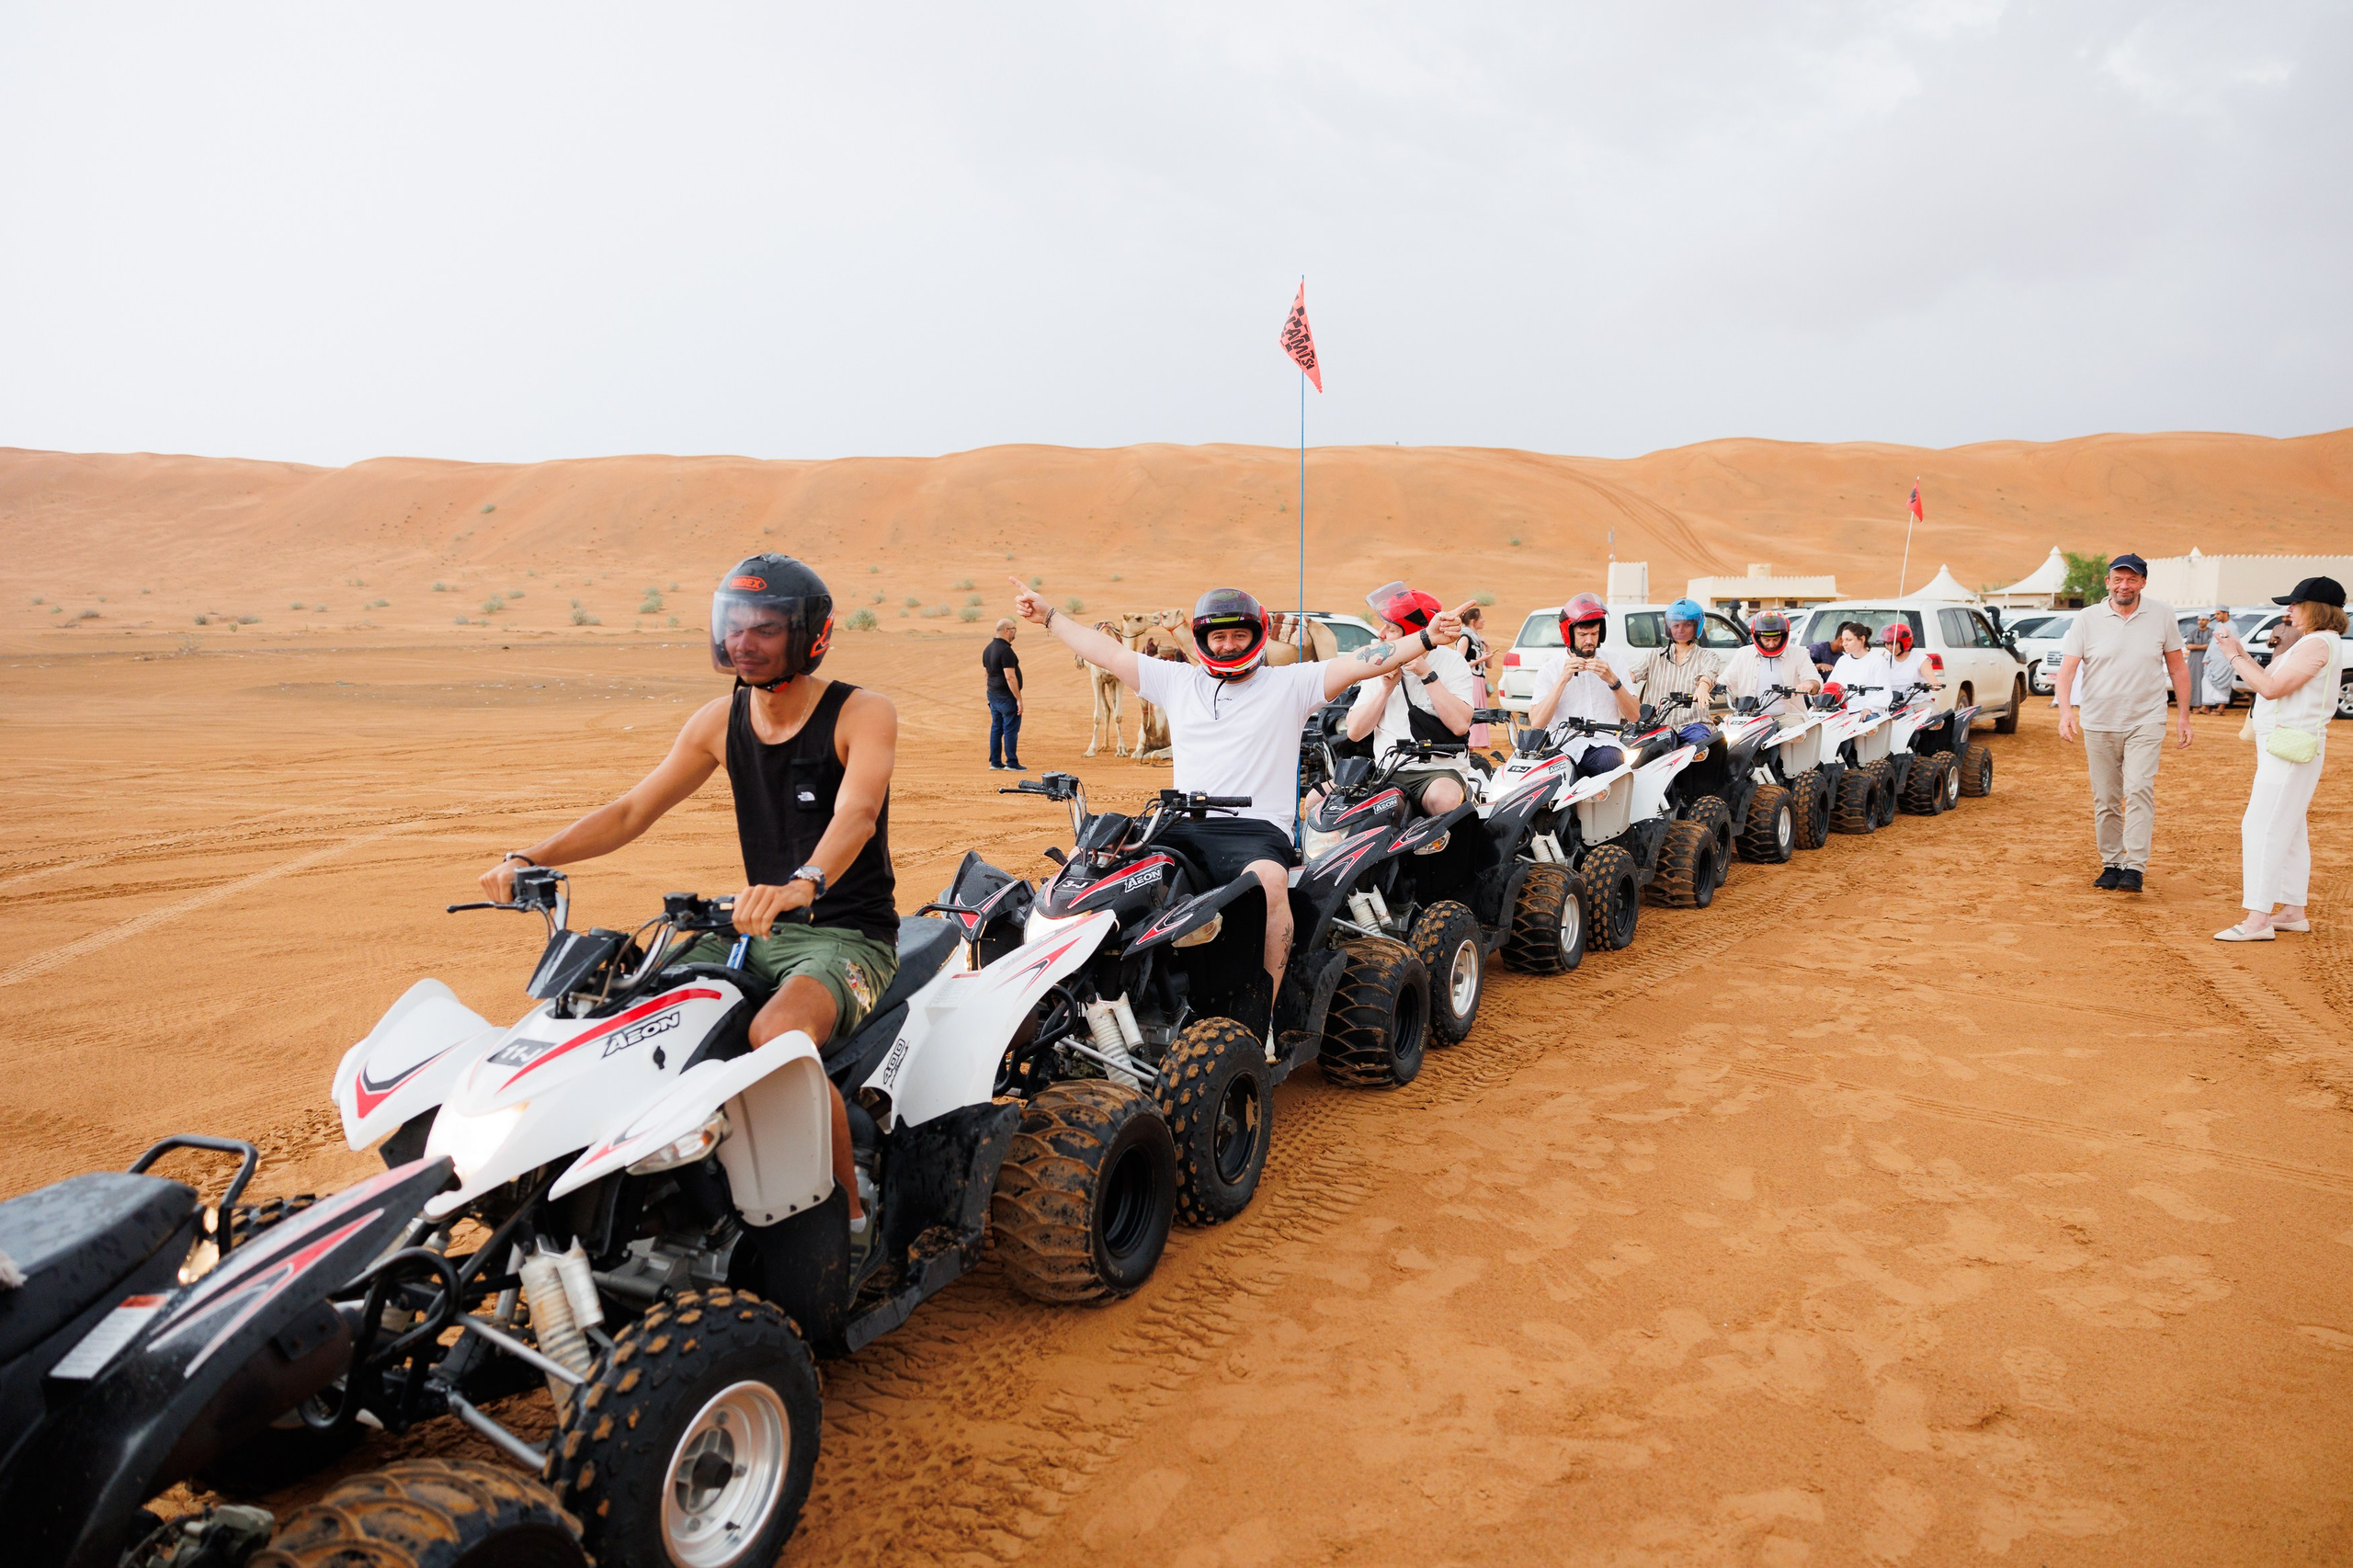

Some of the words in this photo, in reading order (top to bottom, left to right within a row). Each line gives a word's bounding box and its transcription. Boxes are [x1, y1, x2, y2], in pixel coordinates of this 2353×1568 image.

[1375, 798, 1398, 813] AEON
[1125, 868, 1162, 892] AEON
[600, 1011, 680, 1059] AEON
[883, 1038, 905, 1085] 400
